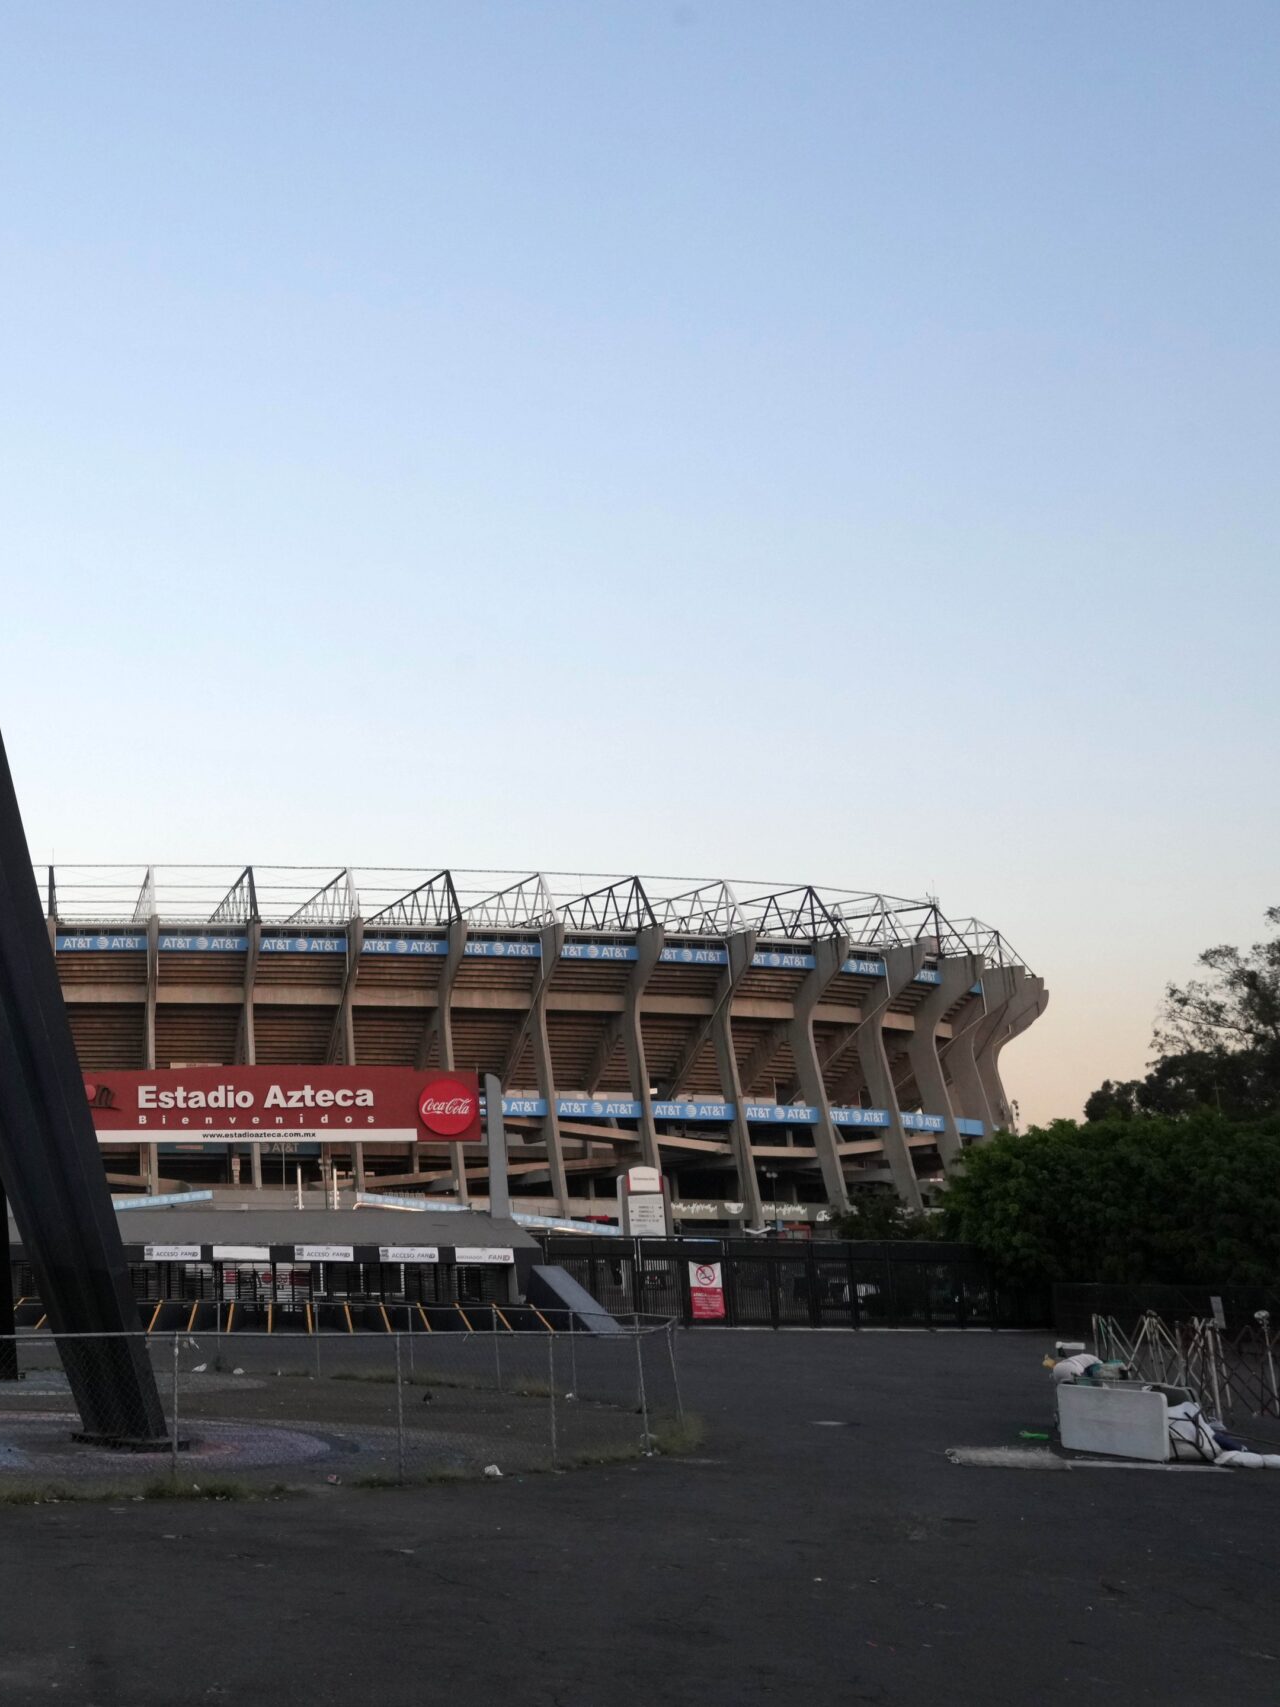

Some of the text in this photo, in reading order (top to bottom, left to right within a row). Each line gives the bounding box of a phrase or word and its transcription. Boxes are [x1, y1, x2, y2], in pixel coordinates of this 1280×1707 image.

[63, 938, 140, 948] AT&T AT&T
[162, 938, 239, 949] AT&T AT&T
[262, 940, 339, 951] AT&T AT&T
[362, 941, 439, 953] AT&T AT&T
[507, 944, 535, 955] AT&T
[561, 946, 629, 958] T&T AT&T
[696, 951, 721, 962] AT&T
[782, 956, 807, 967] AT&T
[859, 962, 880, 973] AT&T
[138, 1085, 375, 1109] Estadio Azteca
[510, 1102, 538, 1112] AT&T
[560, 1103, 633, 1114] AT&T AT&T
[655, 1105, 726, 1116] AT&T AT&T
[746, 1107, 812, 1119] AT&T AT&T
[863, 1112, 884, 1123] AT&T
[202, 1131, 316, 1139] www.estadioazteca.com.mx
